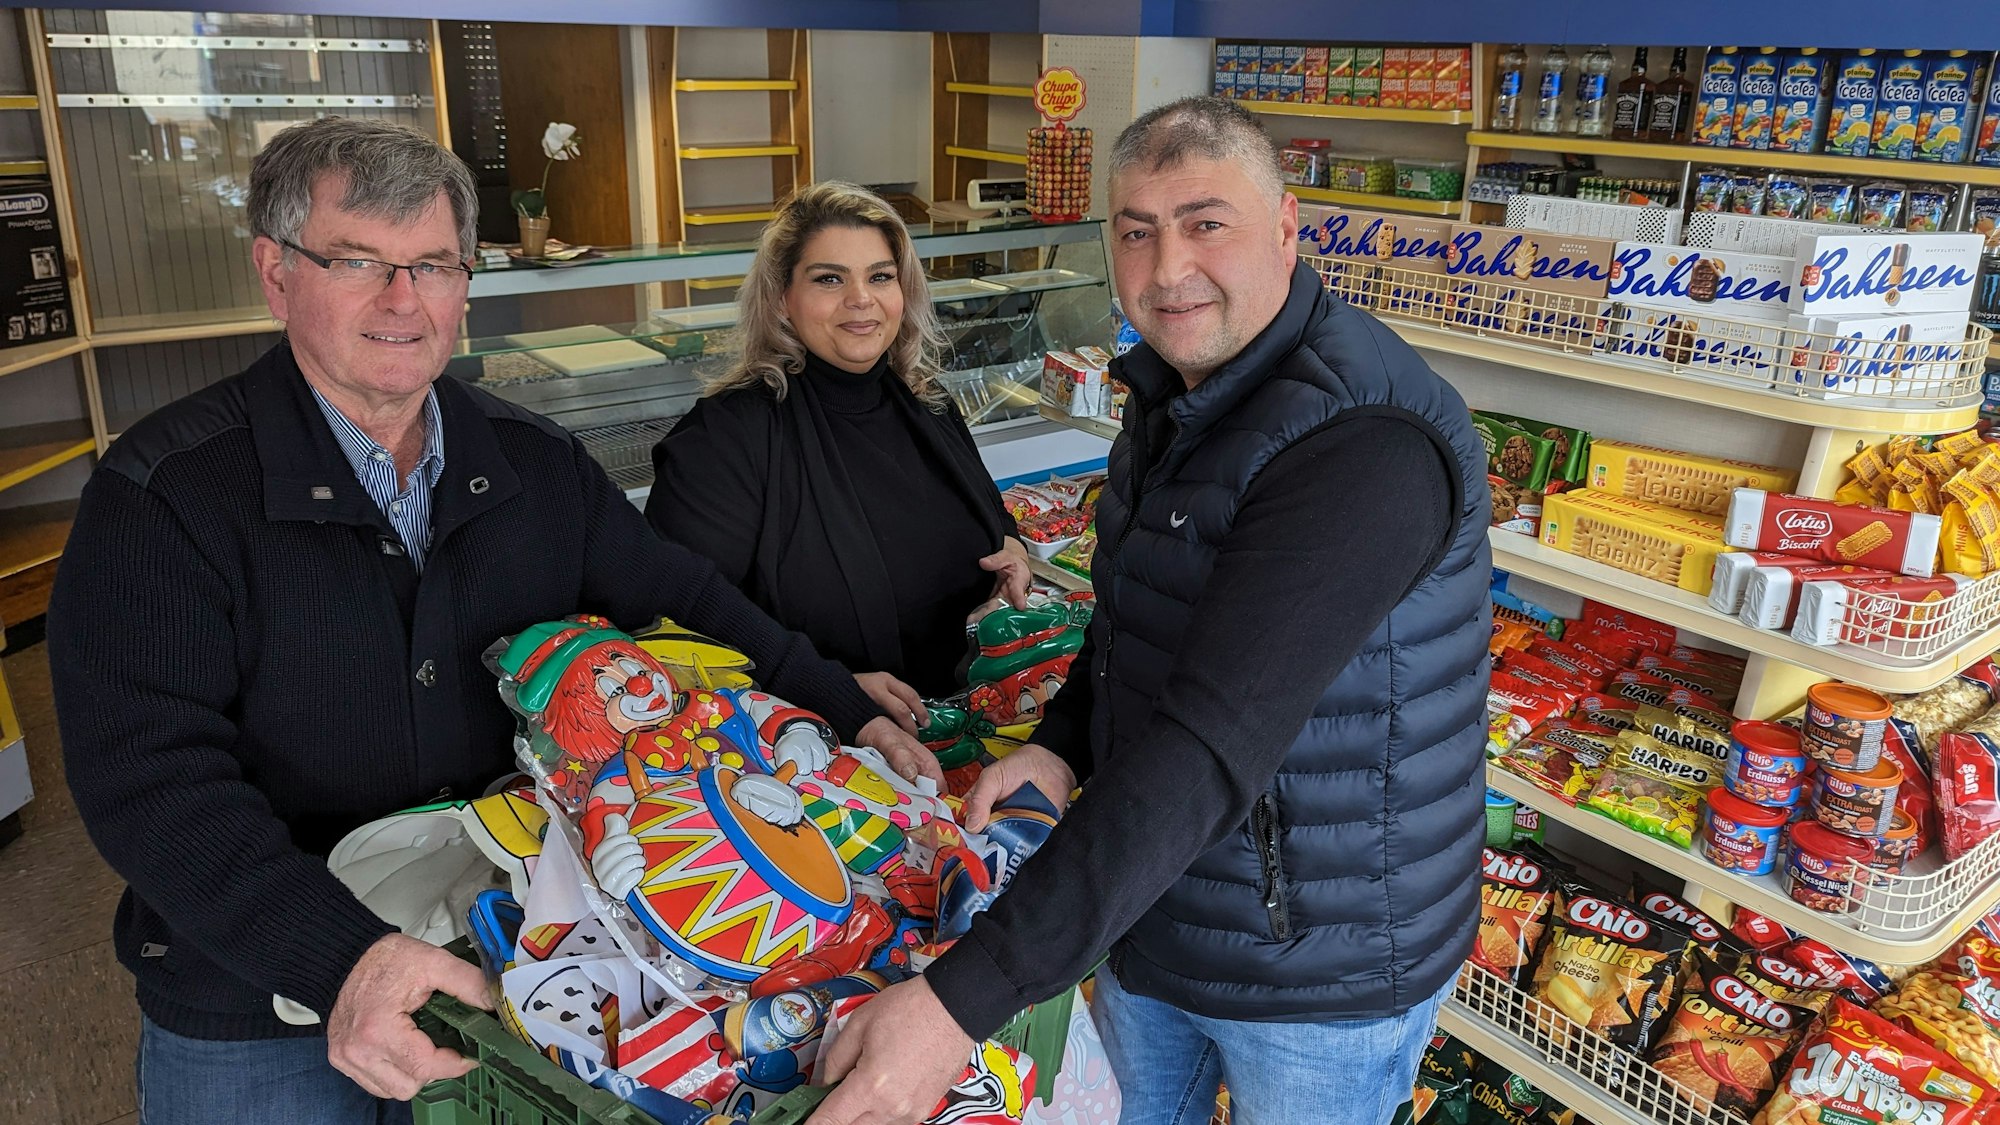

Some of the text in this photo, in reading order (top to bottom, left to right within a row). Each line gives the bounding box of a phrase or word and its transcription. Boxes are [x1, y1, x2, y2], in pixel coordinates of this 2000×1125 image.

[1216, 72, 1234, 80] DURST
[1260, 74, 1280, 82] DURST
[1330, 78, 1351, 86] DURST
[1355, 78, 1379, 86] DURST
[1382, 79, 1406, 87] DURST
[1436, 80, 1458, 88] DURST
[1043, 81, 1078, 94] Chupa
[1041, 93, 1077, 112] Chups
[0, 198, 42, 211] eLonghi
[1319, 215, 1450, 260] Bahsen
[1446, 231, 1611, 280] Bahsen
[1608, 248, 1790, 302] Bahsen
[1642, 476, 1720, 508] LEIBNIZ
[1563, 497, 1636, 518] LEIBNIZ
[1663, 524, 1720, 540] KEKS
[1586, 491, 1724, 532] LEIBNIZ KEK
[1784, 512, 1827, 530] Lotus
[1777, 538, 1822, 550] Biscoff
[1954, 524, 1969, 552] MINIS
[1590, 536, 1659, 572] LEIBNIZ
[1862, 600, 1893, 616] Lotu
[1620, 683, 1668, 708] HARI
[1811, 706, 1831, 723] ültje
[1654, 724, 1729, 762] HARIBO
[1808, 725, 1852, 746] EXTRA ROAST
[1629, 746, 1709, 783] HARIBO
[1748, 751, 1771, 766] ültje
[1746, 768, 1786, 784] Erdnüsse
[1830, 776, 1852, 793] ültje
[1826, 794, 1874, 814] EXTRA ROAST
[1514, 812, 1538, 830] GLES
[1714, 816, 1733, 832] ültje
[1714, 834, 1752, 853] Erdnüsse
[1800, 854, 1823, 870] ültje
[1800, 872, 1848, 892] Kessel Nüss
[1481, 883, 1549, 916] tillas
[1570, 898, 1648, 939] Chio
[1568, 960, 1600, 974] Nacho
[1760, 958, 1838, 988] Chio
[1716, 978, 1791, 1028] Chio
[1789, 1043, 1948, 1125] JUMBOS
[1472, 1082, 1526, 1125] Chipsfri
[1832, 1100, 1864, 1116] Classic
